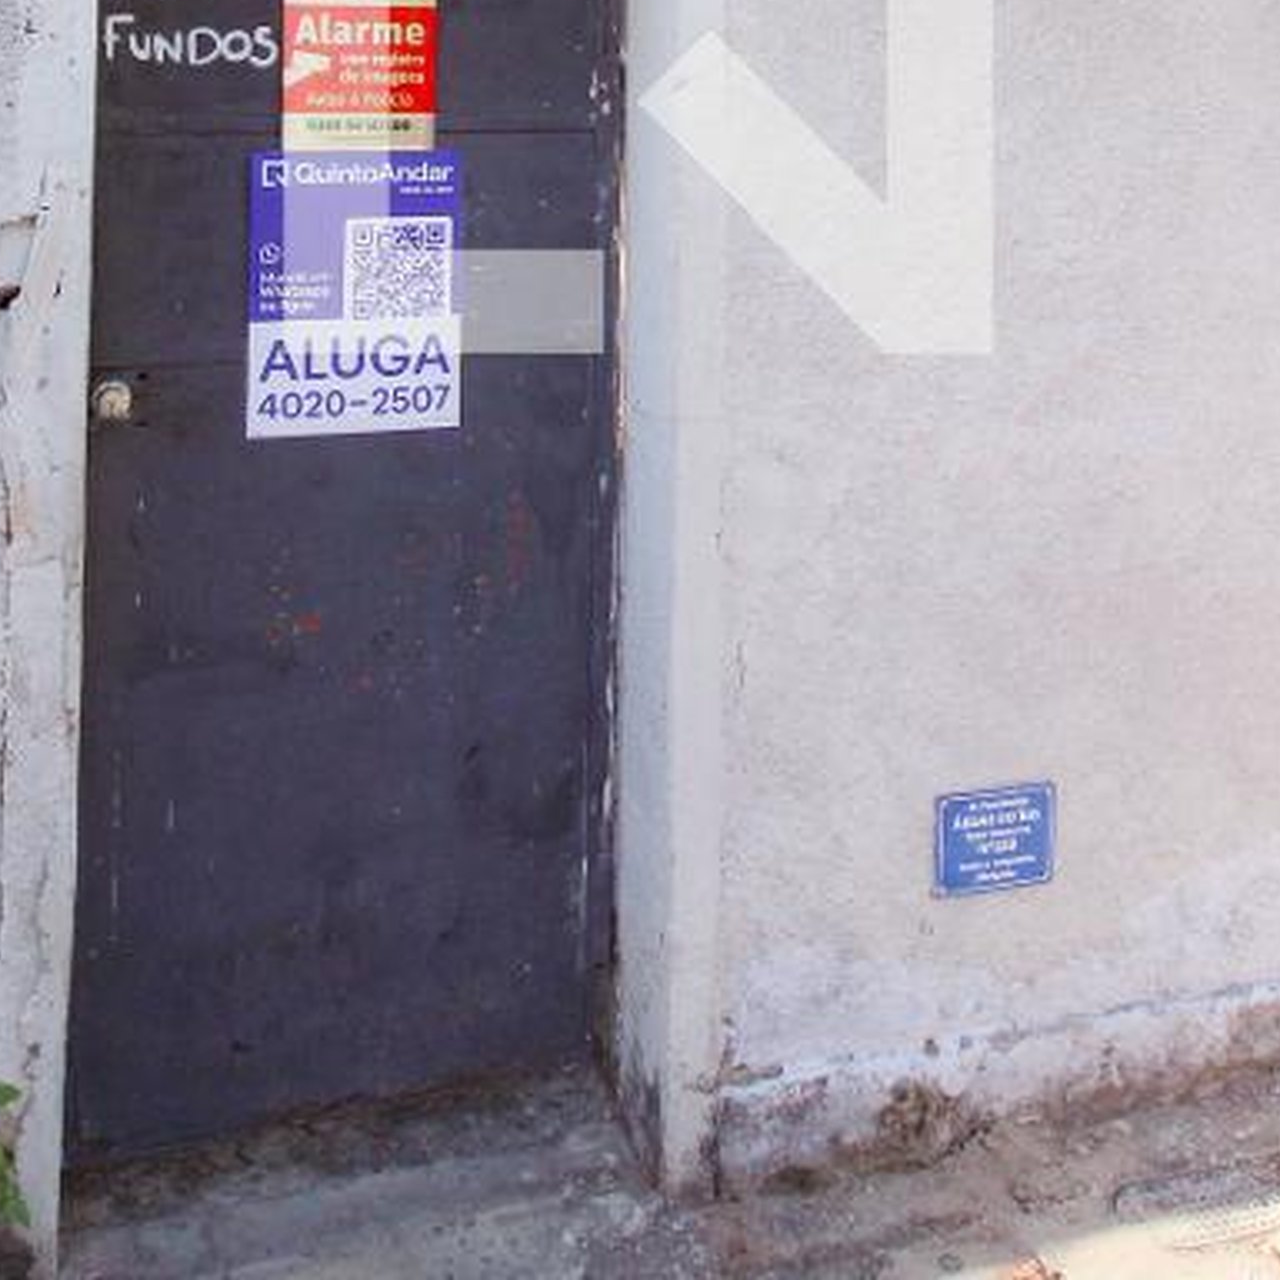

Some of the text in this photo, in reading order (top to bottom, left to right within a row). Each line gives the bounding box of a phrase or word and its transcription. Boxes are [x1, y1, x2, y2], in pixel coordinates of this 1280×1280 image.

[102, 14, 279, 68] FUNDOS
[295, 14, 426, 45] Alarme
[294, 162, 455, 185] QuintoAndar
[259, 334, 451, 382] ALUGA
[257, 384, 451, 419] 4020-2507
